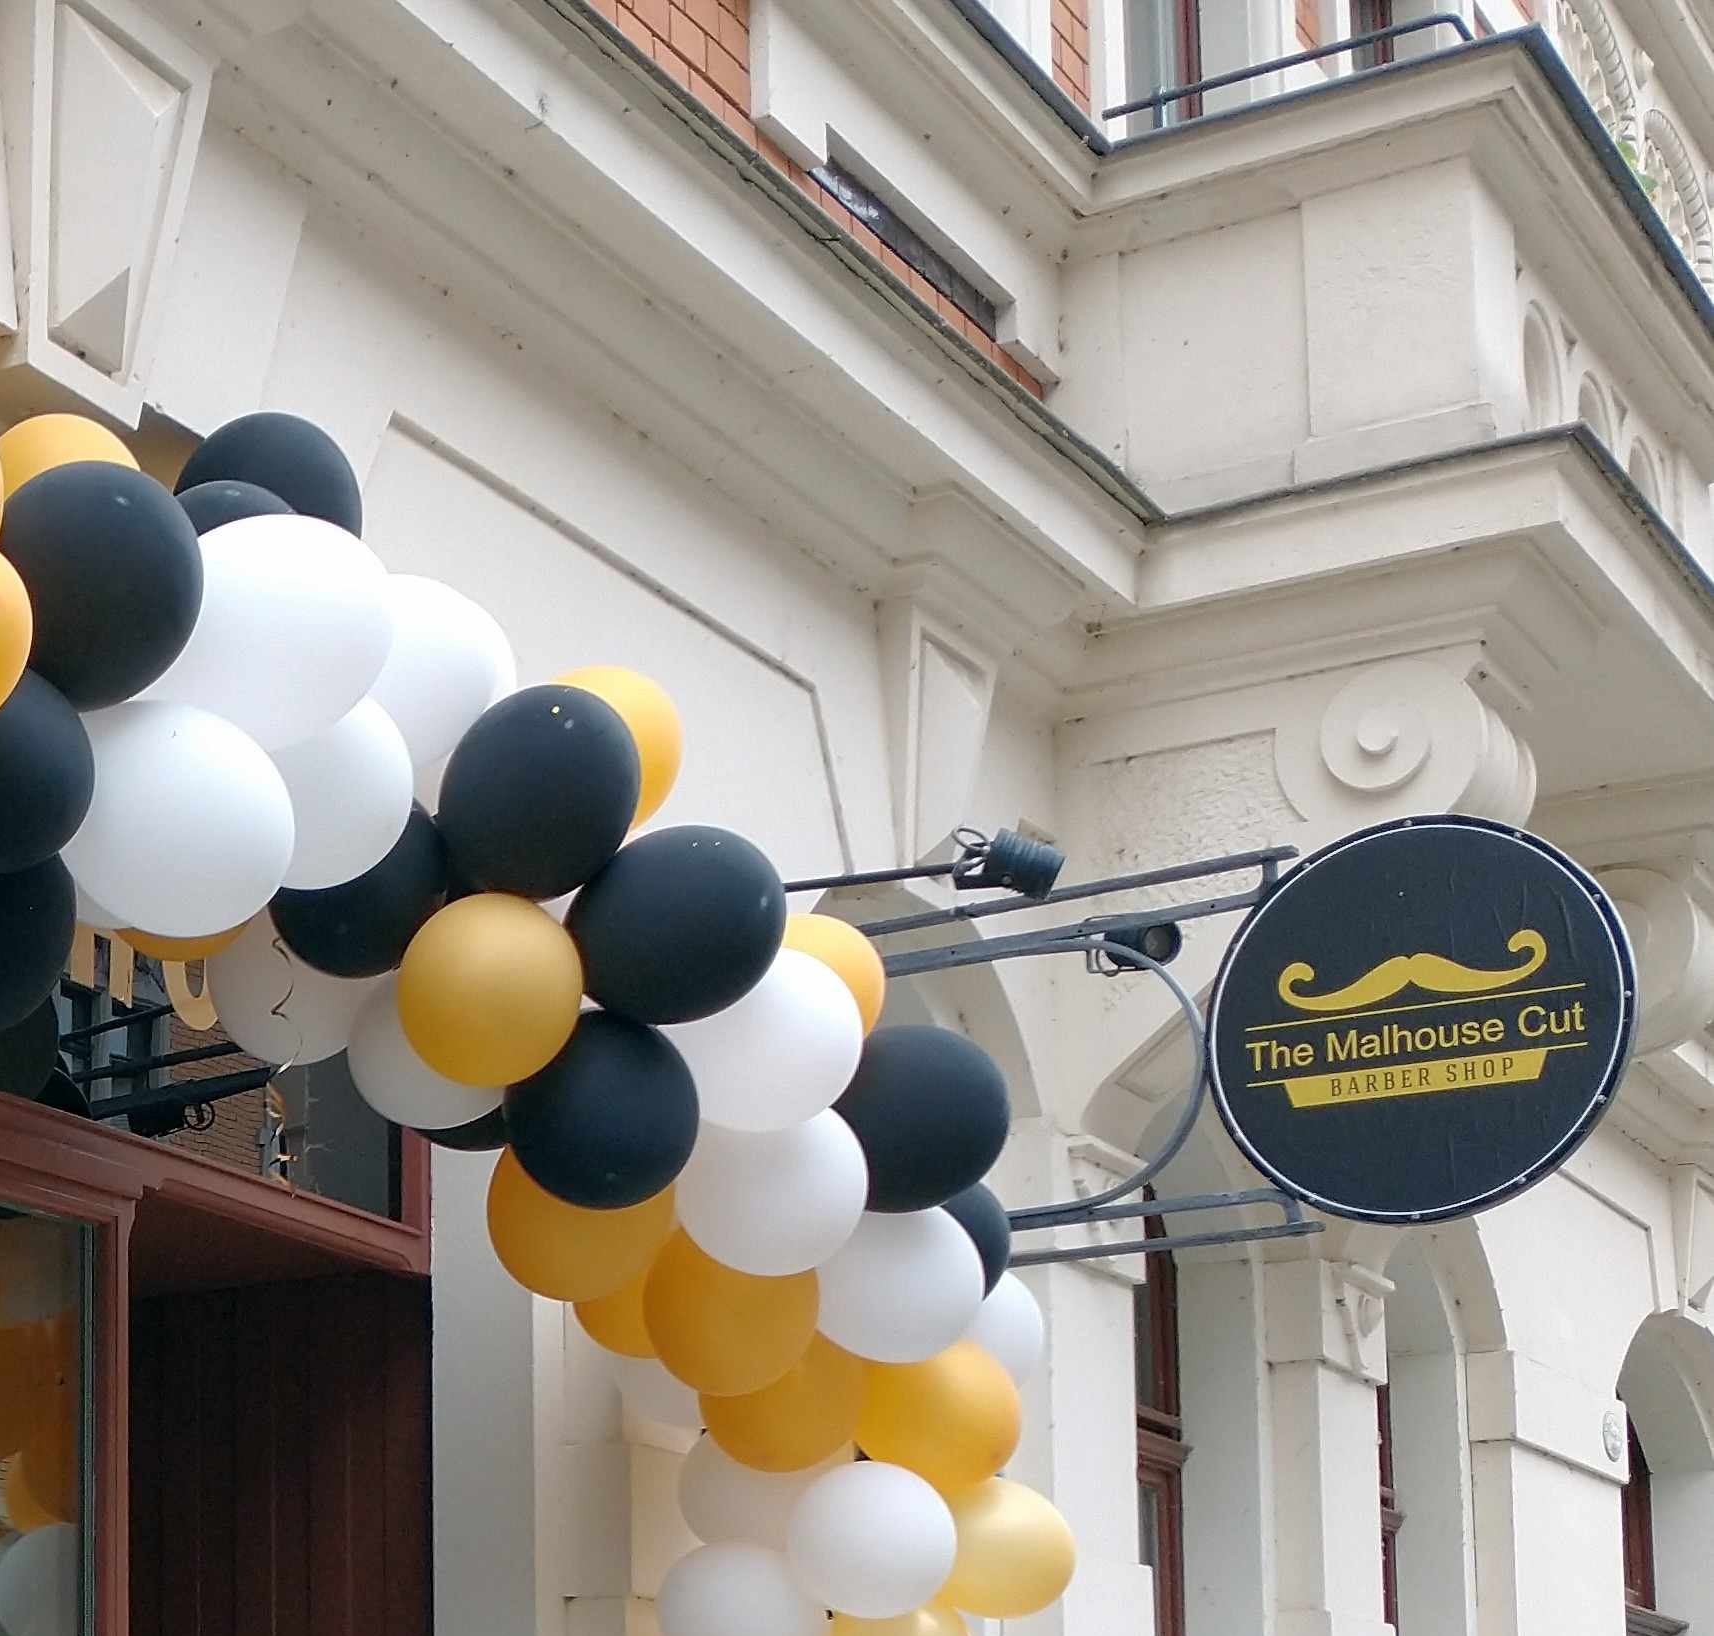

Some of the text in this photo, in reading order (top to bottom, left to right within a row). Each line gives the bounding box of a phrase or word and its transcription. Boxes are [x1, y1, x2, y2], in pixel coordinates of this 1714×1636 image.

[1246, 1001, 1586, 1072] The Malhouse Cut
[1330, 1056, 1516, 1097] BARBER SHOP
